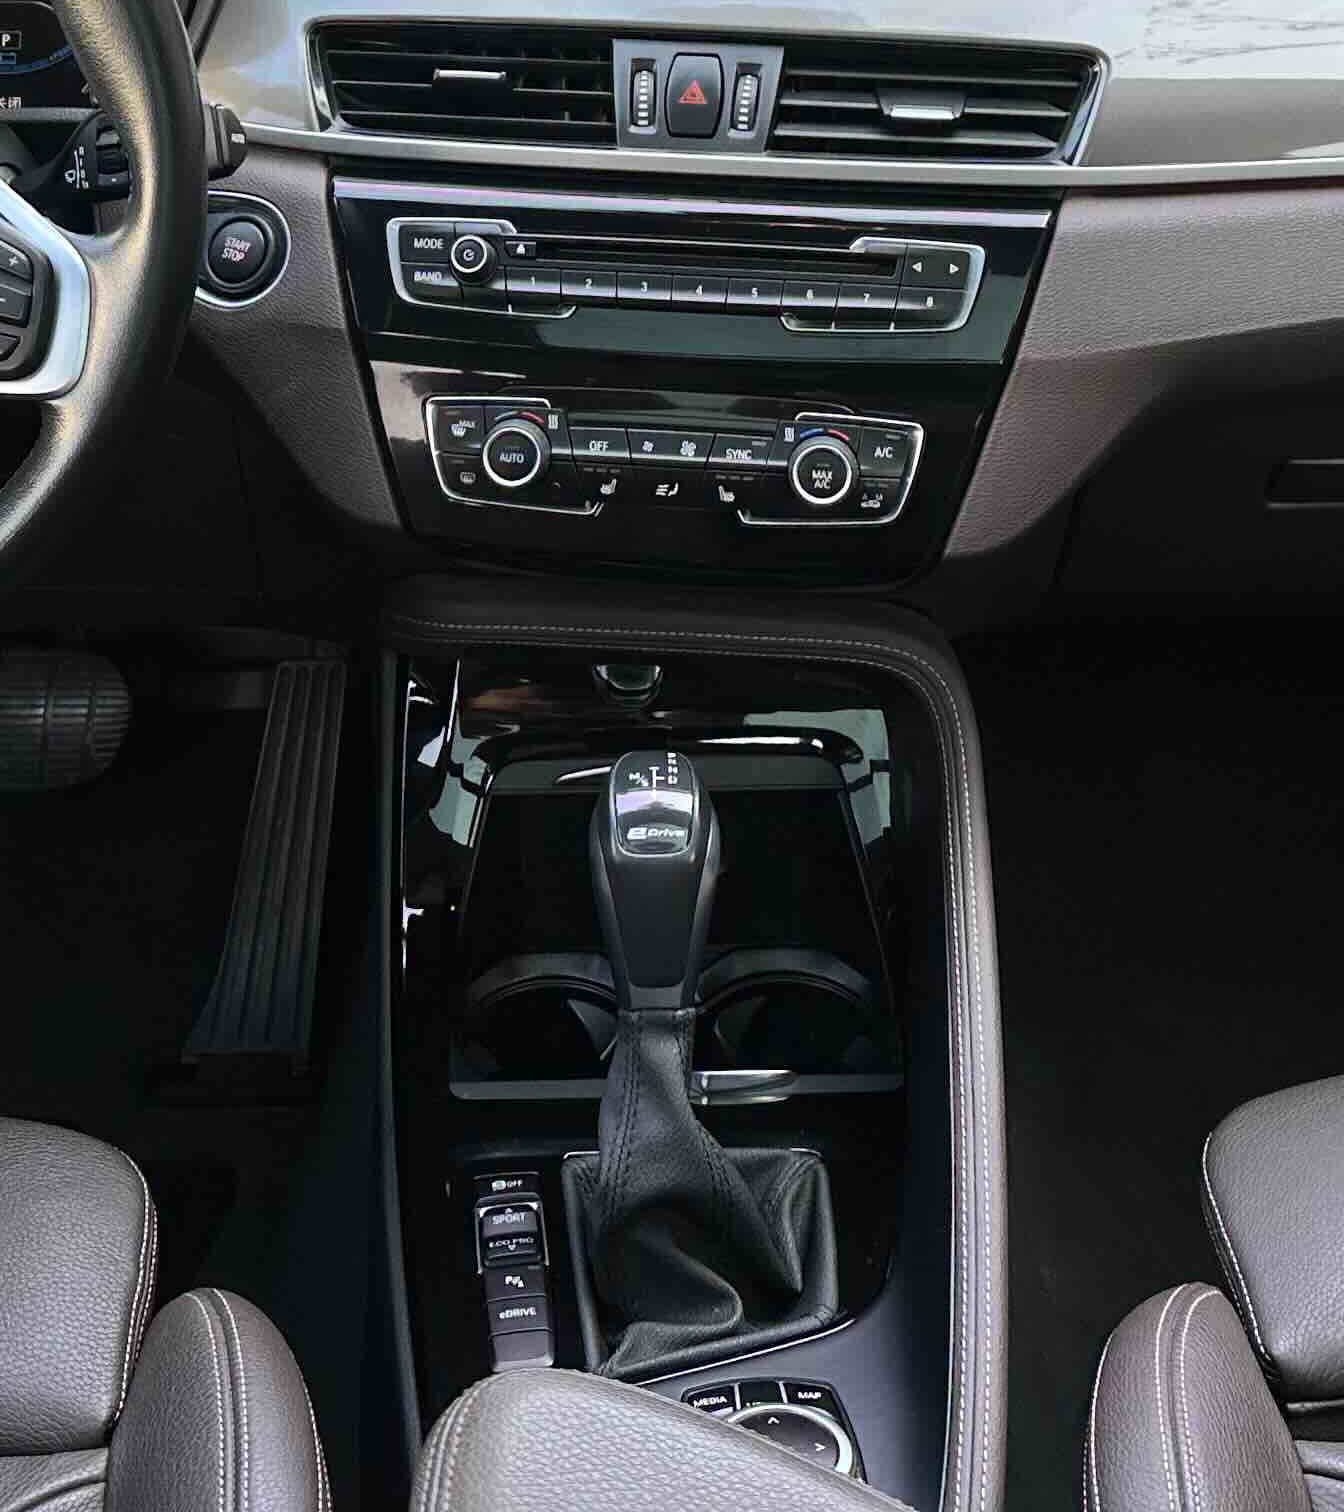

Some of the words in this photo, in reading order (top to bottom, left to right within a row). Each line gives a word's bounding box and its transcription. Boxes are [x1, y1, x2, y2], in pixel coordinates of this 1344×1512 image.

[1, 33, 11, 47] P
[224, 237, 251, 253] START
[413, 238, 445, 250] MODE
[221, 247, 246, 262] STOP
[413, 270, 443, 282] BAND
[584, 278, 593, 290] 2
[639, 281, 649, 293] 3
[695, 283, 704, 296] 4
[750, 287, 759, 298] 5
[862, 292, 871, 305] 7
[588, 440, 609, 452] OFF
[499, 453, 525, 465] AUTO
[725, 448, 753, 461] SYNC
[873, 447, 894, 459] A/C
[811, 470, 834, 481] MAX
[813, 479, 832, 490] A/C
[492, 1212, 526, 1225] SPORT
[488, 1239, 510, 1248] ECO
[498, 1306, 537, 1320] eDRIVE
[692, 1395, 728, 1408] MEDIA
[797, 1391, 822, 1400] MAP
